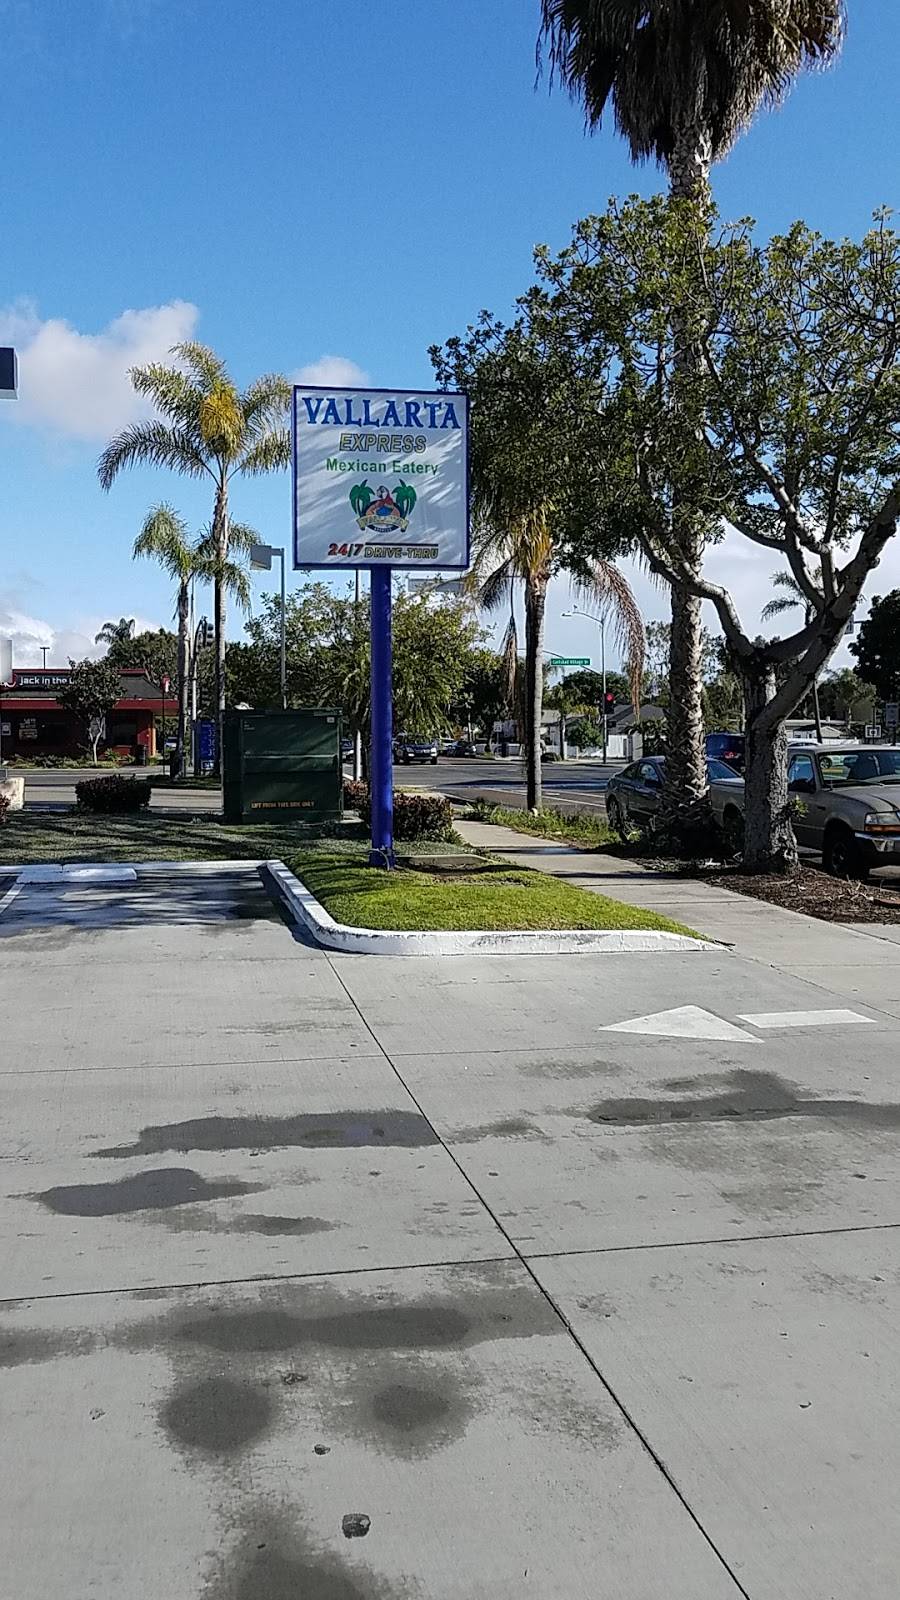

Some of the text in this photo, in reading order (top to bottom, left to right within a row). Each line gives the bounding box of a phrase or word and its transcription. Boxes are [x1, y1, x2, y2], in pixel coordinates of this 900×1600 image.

[302, 397, 461, 430] VALLARTA
[339, 433, 427, 454] EXPRESS
[326, 458, 438, 475] Mexican Eatery
[328, 542, 438, 560] 24/7 DRIVE-THRU
